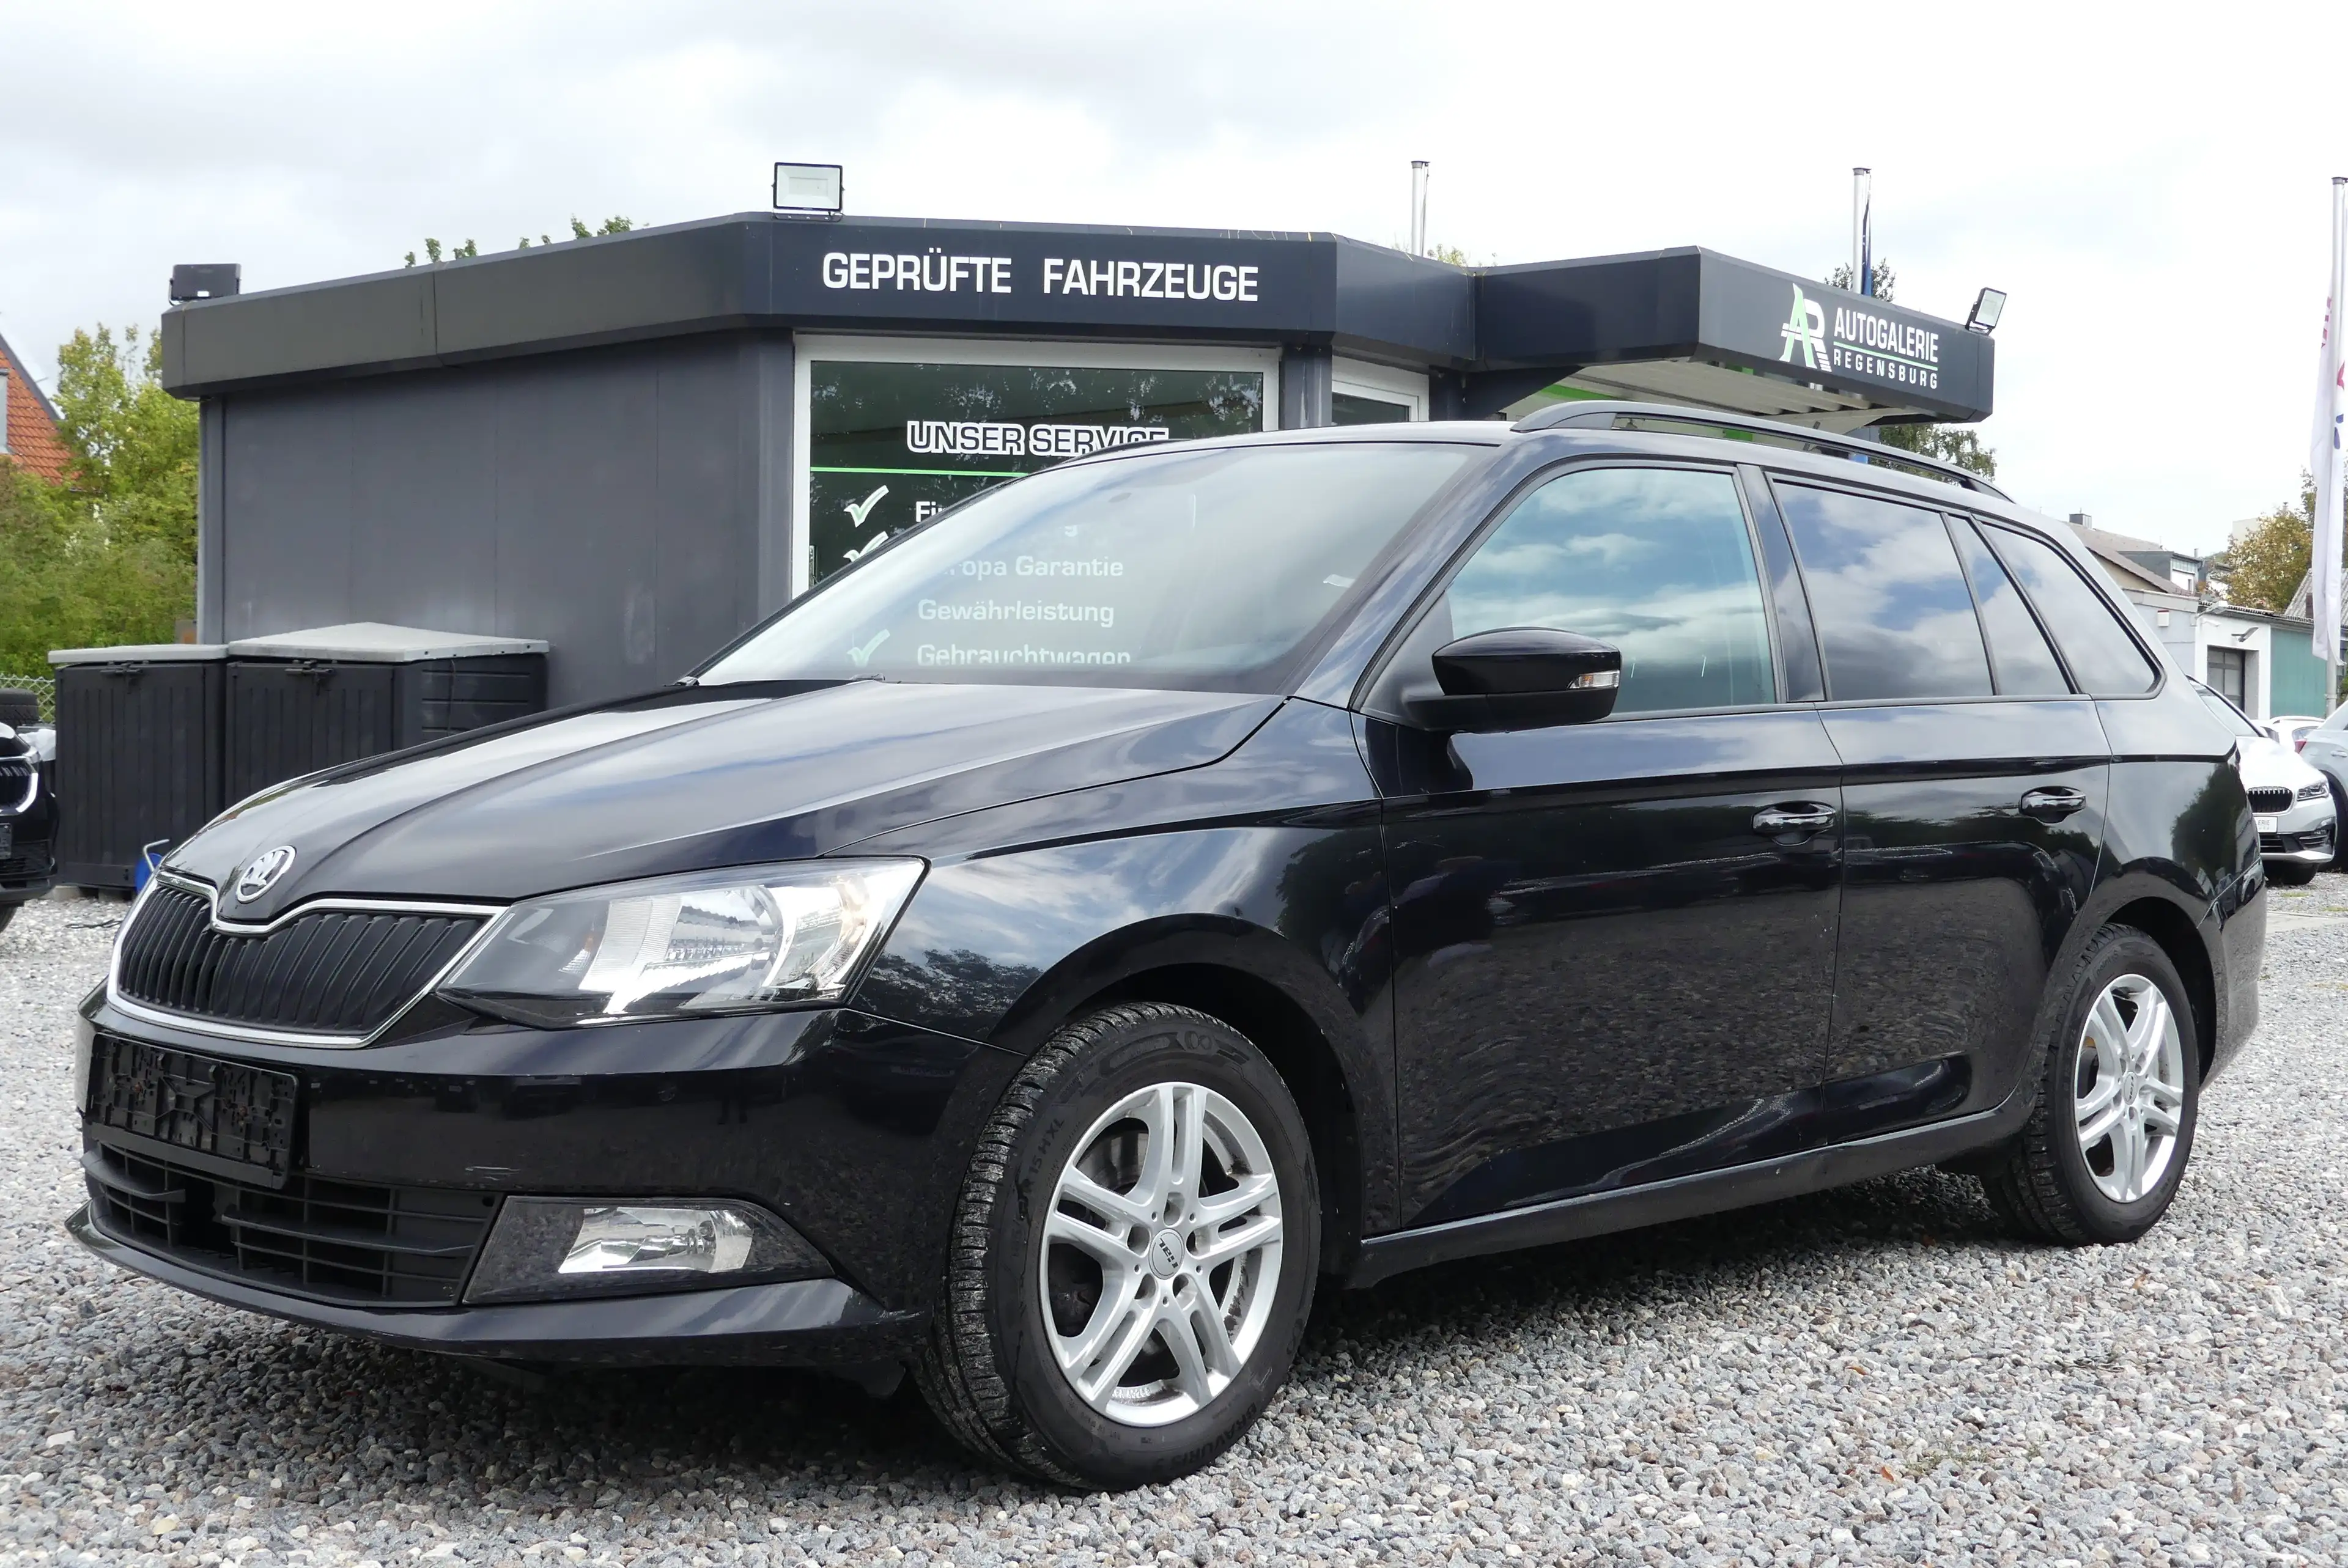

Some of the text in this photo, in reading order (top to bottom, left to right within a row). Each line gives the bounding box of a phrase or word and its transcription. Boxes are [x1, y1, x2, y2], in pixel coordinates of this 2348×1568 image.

[822, 248, 1258, 301] GEPRÜFTE FAHRZEUGE
[1834, 307, 1939, 363] AUTOGALERIE
[1834, 349, 1938, 389] REGENSBURG
[907, 421, 1024, 455] UNSER
[1015, 555, 1124, 577] Garantie
[918, 598, 1115, 628] Gewährleistung
